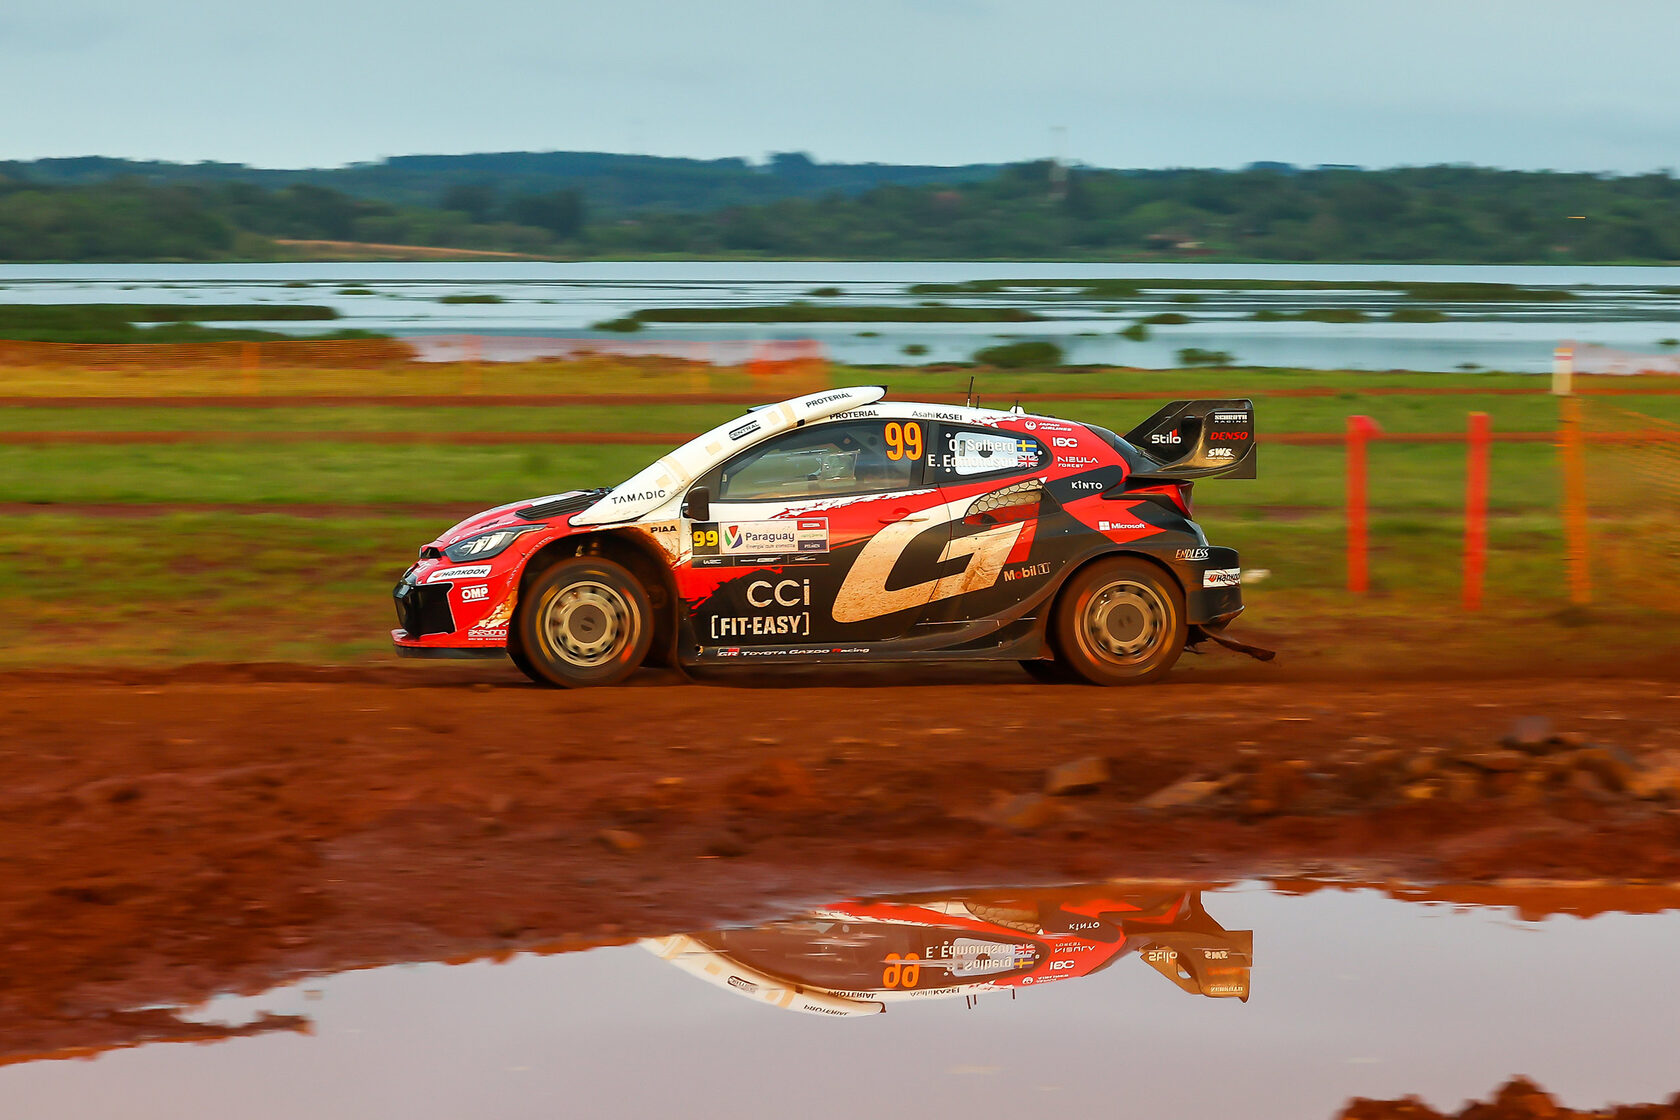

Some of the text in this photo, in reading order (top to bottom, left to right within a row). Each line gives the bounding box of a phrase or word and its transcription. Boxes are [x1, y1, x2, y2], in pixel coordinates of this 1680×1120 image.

[805, 391, 853, 408] PROTERIAL
[829, 409, 879, 420] PROTERIAL
[912, 410, 963, 421] AsahiKASEI
[730, 421, 760, 440] CENTRAL
[1210, 431, 1249, 441] DENSO
[884, 421, 923, 462] 99
[1151, 431, 1182, 445] Stilo
[1207, 447, 1233, 457] SWS
[927, 454, 941, 467] E.
[1071, 480, 1104, 490] KINTO
[611, 489, 666, 505] TAMADIC
[650, 525, 677, 533] PIAA
[1111, 522, 1146, 530] Microsoft
[692, 530, 719, 547] 99
[745, 532, 795, 543] Paraguay
[1175, 548, 1209, 561] ENDLESS
[1003, 566, 1037, 582] Mobil
[461, 586, 489, 600] OMP
[746, 578, 810, 608] CCi
